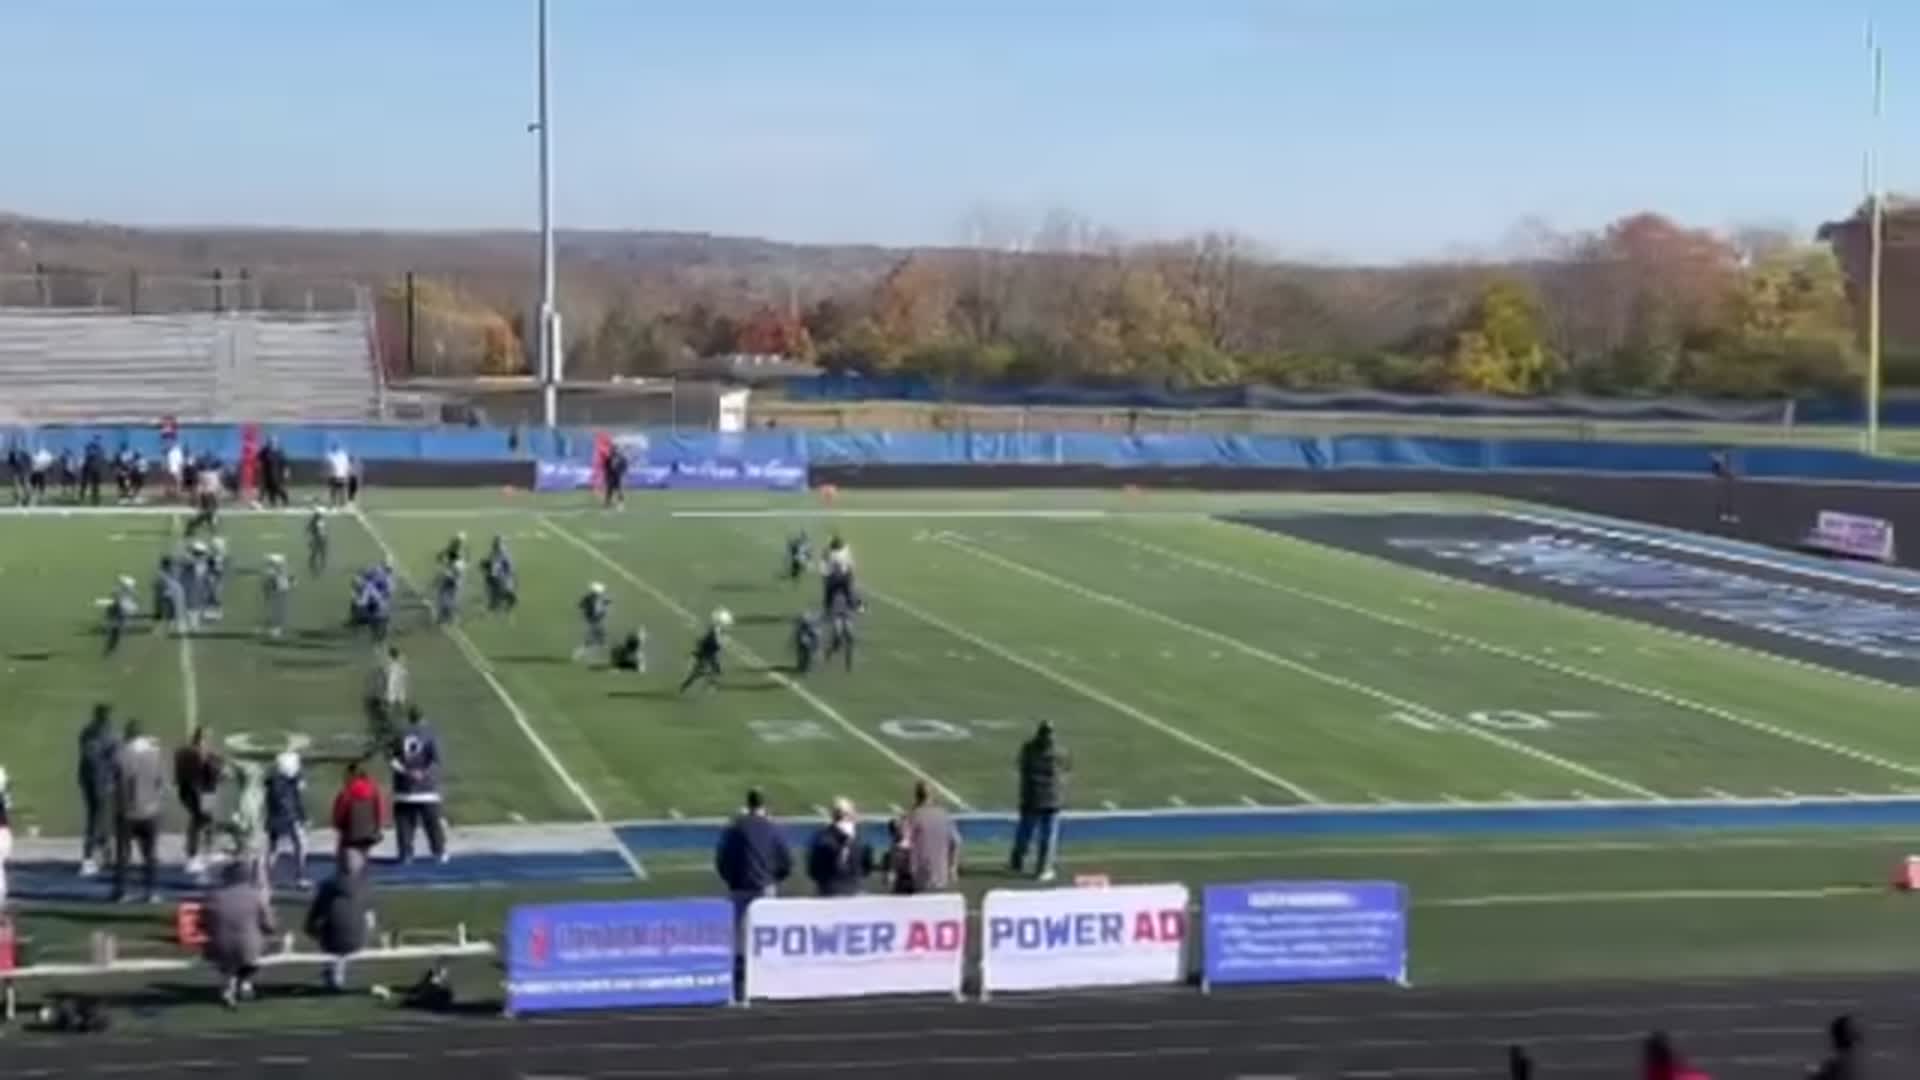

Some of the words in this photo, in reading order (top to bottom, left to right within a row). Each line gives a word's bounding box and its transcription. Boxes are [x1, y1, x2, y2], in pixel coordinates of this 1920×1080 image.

[753, 922, 896, 957] POWER
[906, 919, 961, 951] AD
[989, 912, 1124, 950] POWER
[1133, 909, 1185, 943] AD
